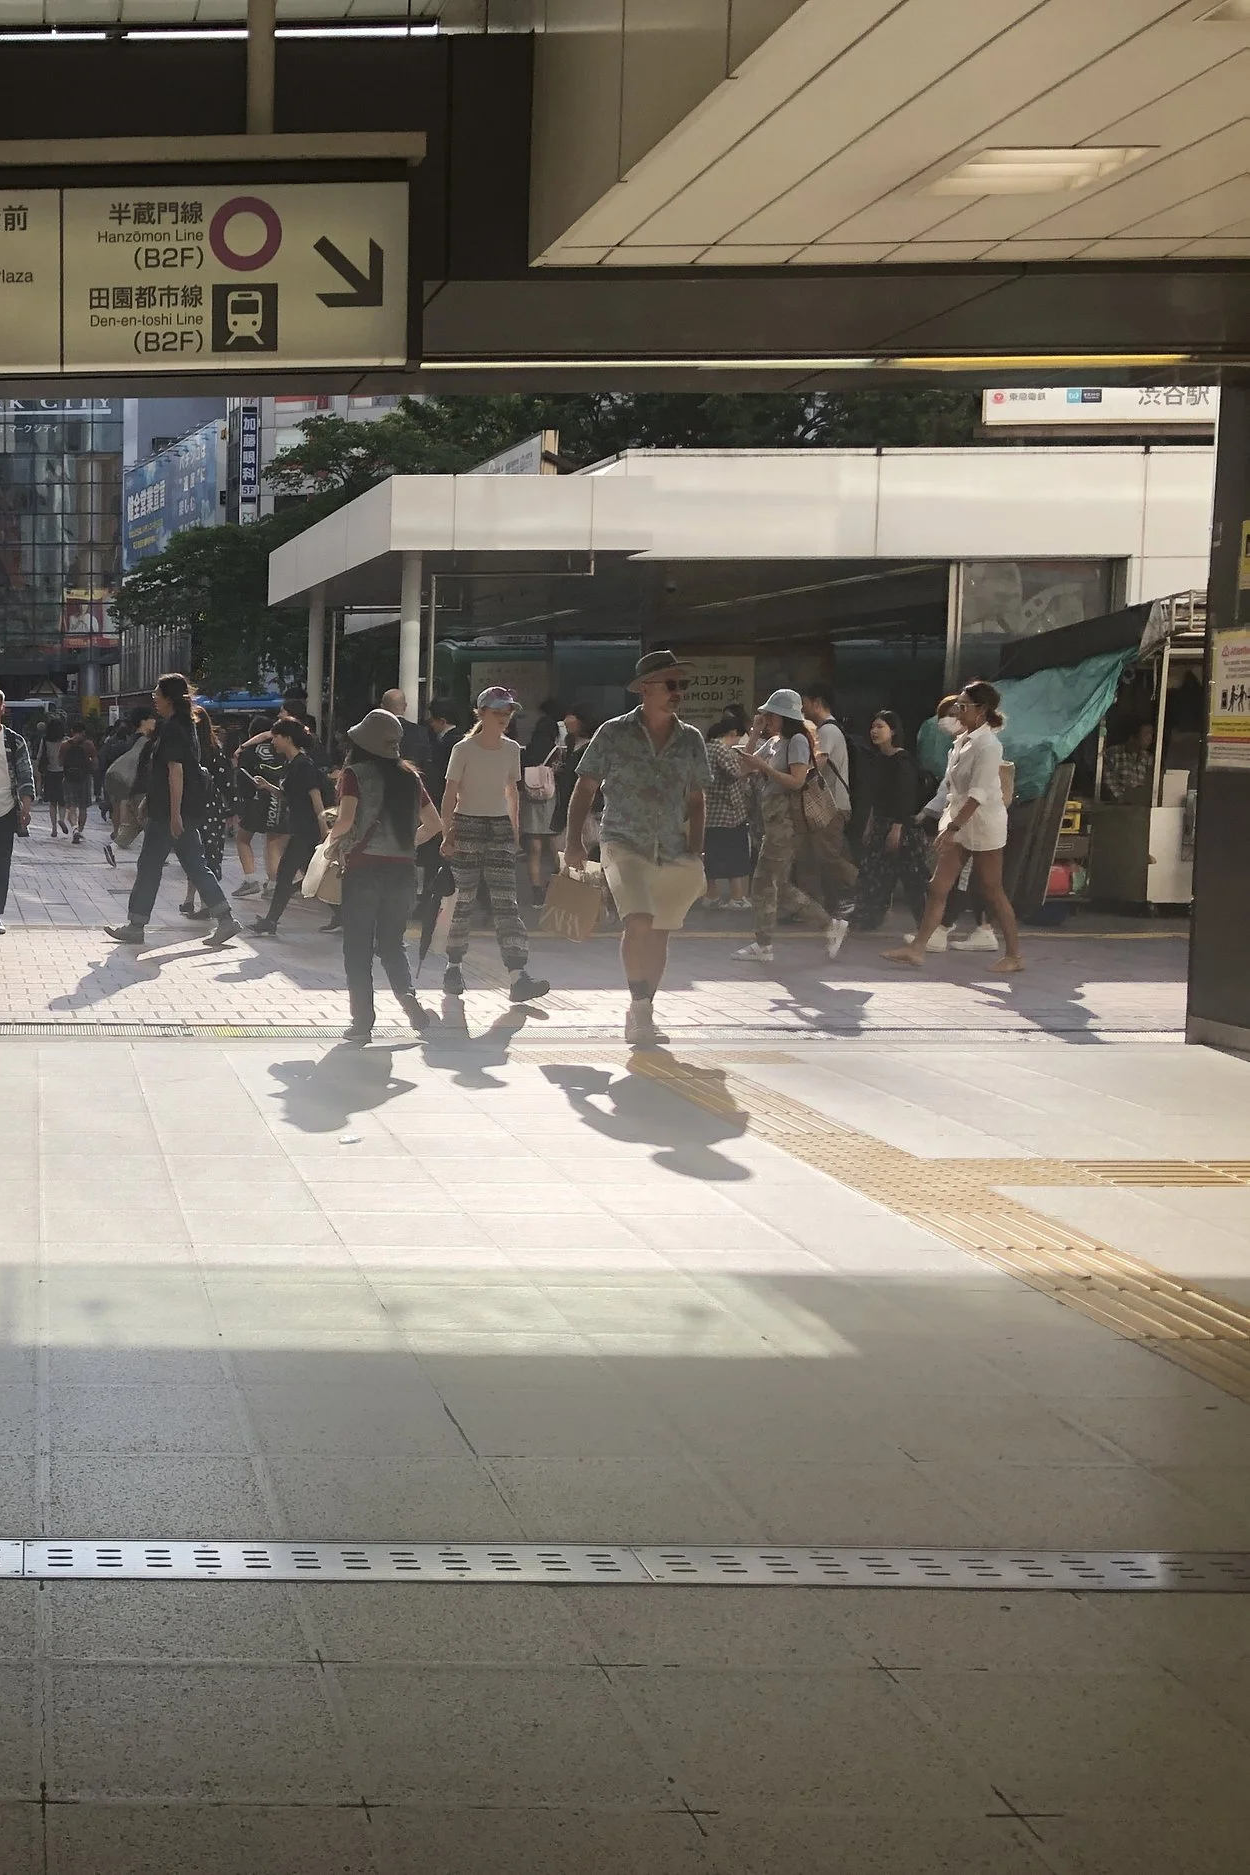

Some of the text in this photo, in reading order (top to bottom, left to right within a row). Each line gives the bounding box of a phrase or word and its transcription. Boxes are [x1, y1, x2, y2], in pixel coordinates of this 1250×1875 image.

[109, 201, 203, 226] 半蔵門線
[97, 229, 204, 244] Hanzōmon Line
[134, 247, 204, 271] (B2F)
[89, 286, 203, 310] 田園都市線
[90, 313, 204, 327] Den-en-toshi Line
[134, 331, 204, 355] (B2F)
[1138, 387, 1210, 406] 渋谷駅
[242, 416, 256, 481] 加藤眼科
[242, 486, 254, 495] 5F
